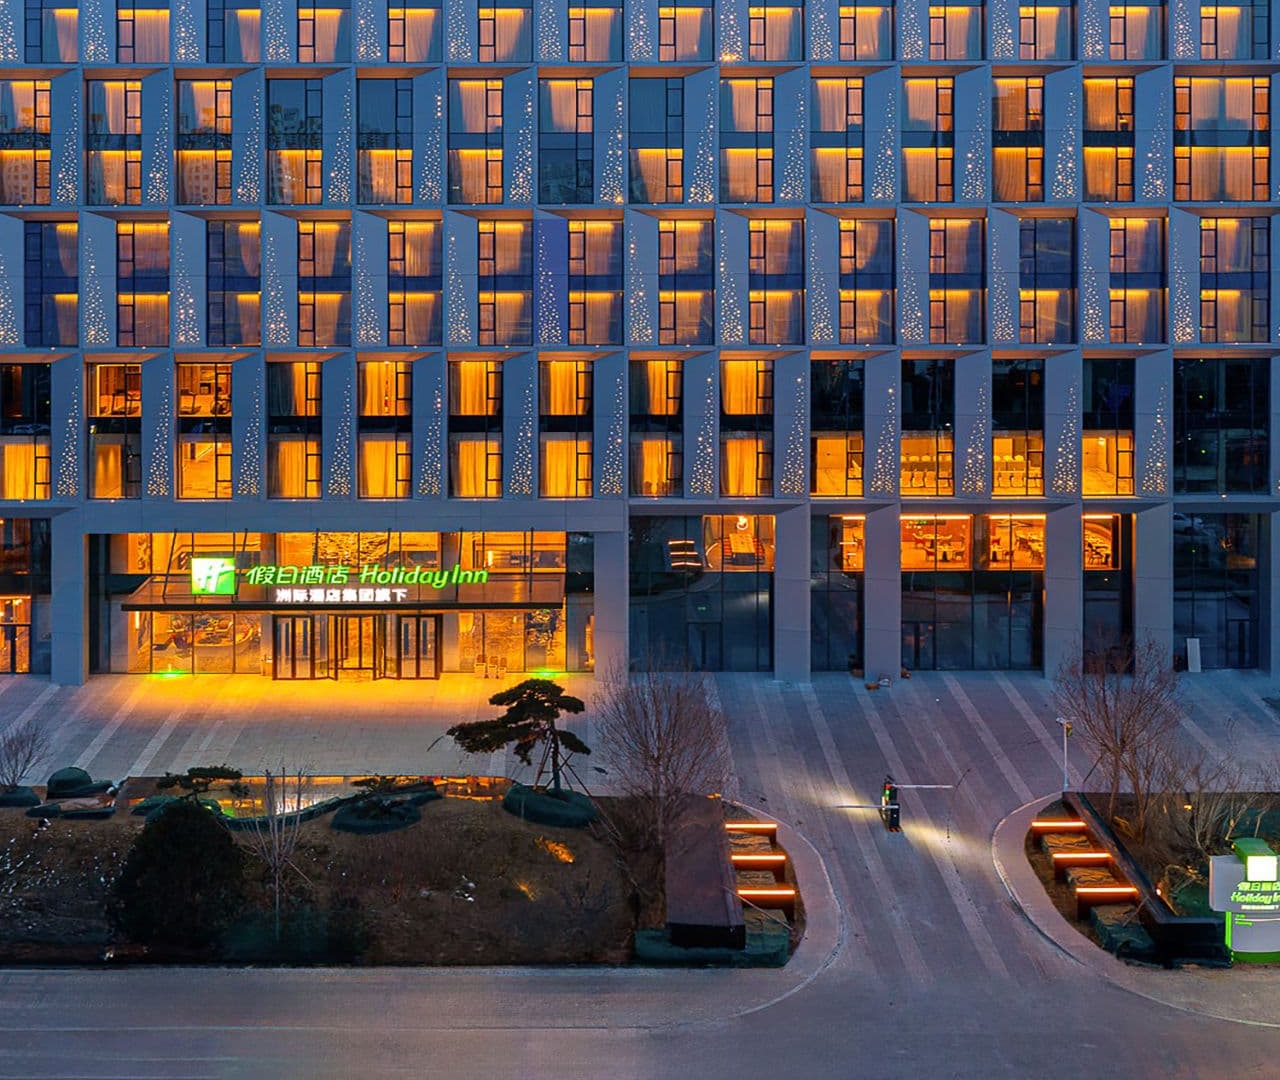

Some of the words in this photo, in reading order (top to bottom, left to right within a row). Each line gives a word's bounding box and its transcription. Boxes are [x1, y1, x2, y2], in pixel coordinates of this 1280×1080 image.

[246, 565, 348, 585] 假日酒店
[359, 565, 451, 589] Holiday
[451, 564, 488, 585] Inn
[1231, 891, 1273, 905] Holiday
